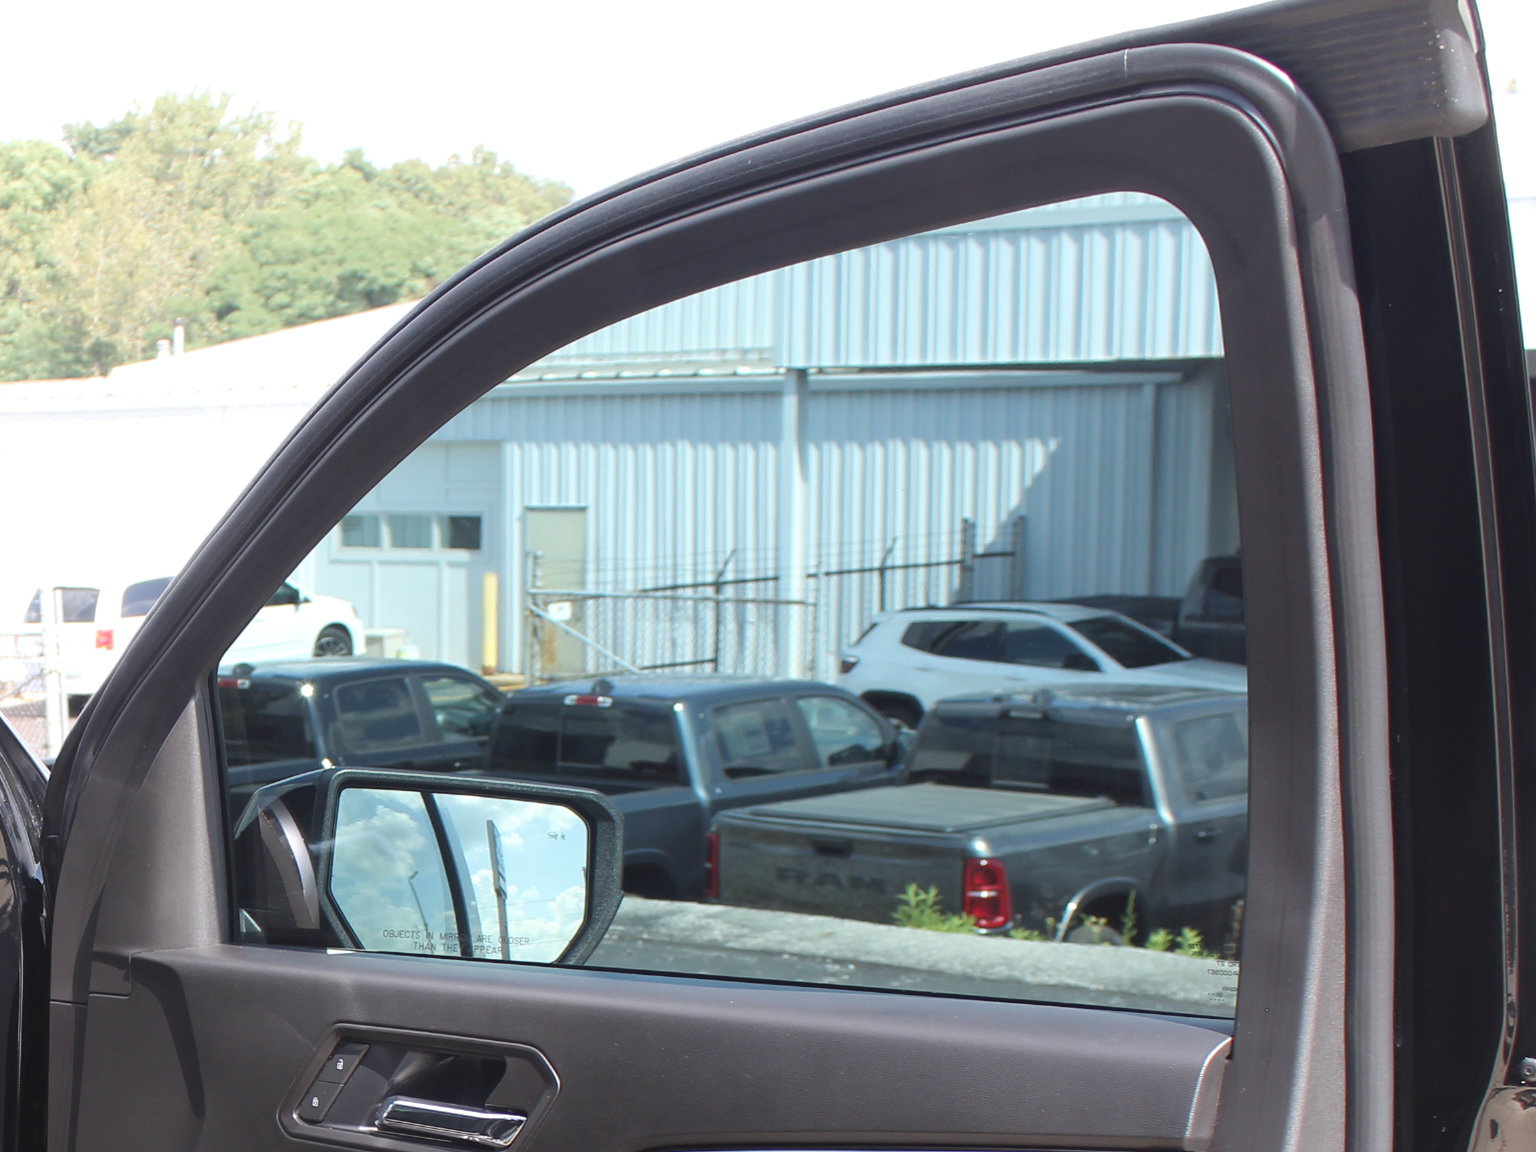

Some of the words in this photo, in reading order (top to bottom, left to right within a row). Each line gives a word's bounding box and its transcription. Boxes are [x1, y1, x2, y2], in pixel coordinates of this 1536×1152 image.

[776, 866, 886, 893] RAM
[383, 930, 420, 939] OBJECTS
[477, 935, 492, 944] ARE
[414, 941, 436, 951] THAN
